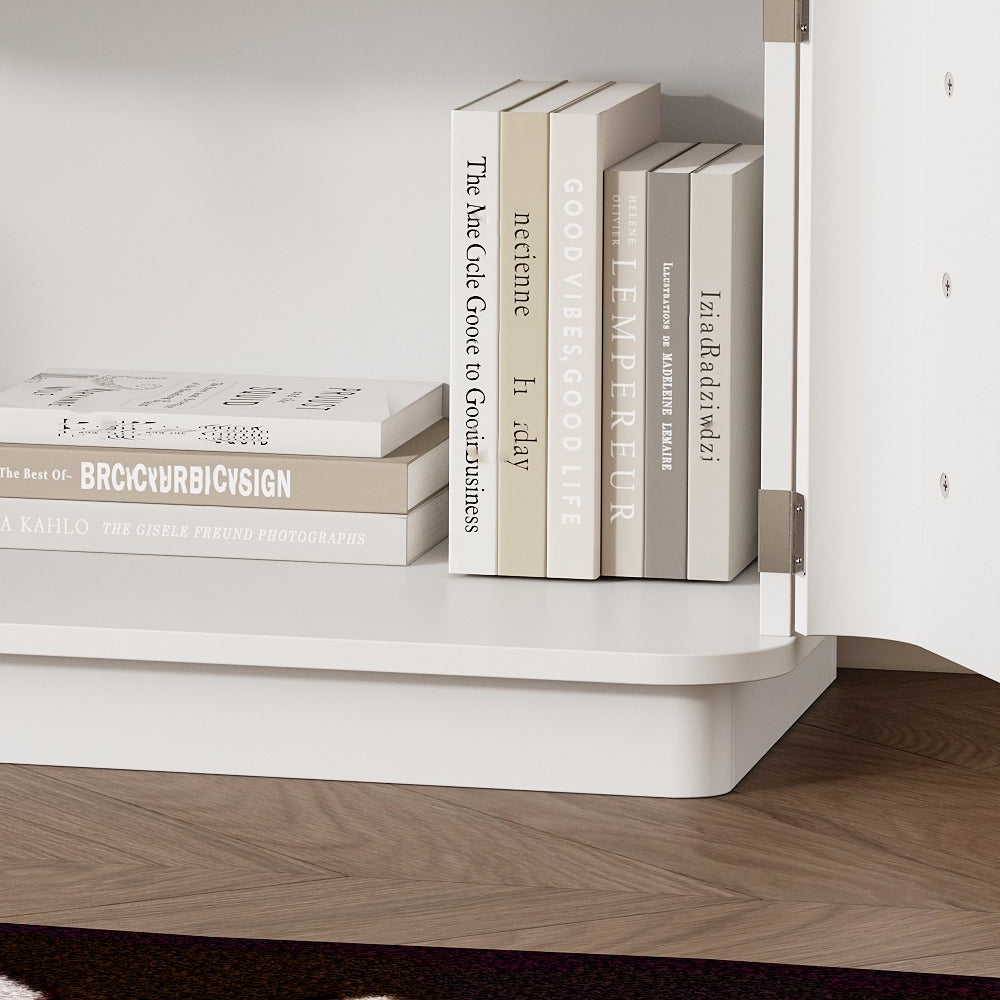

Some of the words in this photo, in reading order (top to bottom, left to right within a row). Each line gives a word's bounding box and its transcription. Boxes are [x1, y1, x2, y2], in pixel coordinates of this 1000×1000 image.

[466, 155, 487, 196] The
[563, 178, 584, 262] GOOD
[611, 194, 621, 246] OLIVIER
[465, 362, 481, 381] to
[609, 257, 637, 524] LEMPEREUR
[661, 352, 673, 416] MADELEINE
[562, 368, 583, 452] GOOD
[661, 422, 673, 471] LEMAIRE
[23, 467, 48, 480] Best
[561, 465, 582, 525] LIFE
[20, 515, 89, 536] KAHLO
[102, 521, 131, 536] THE
[136, 523, 189, 538] GISELE
[193, 525, 254, 541] FREUND
[257, 528, 367, 546] PHOTOGRAPHS
